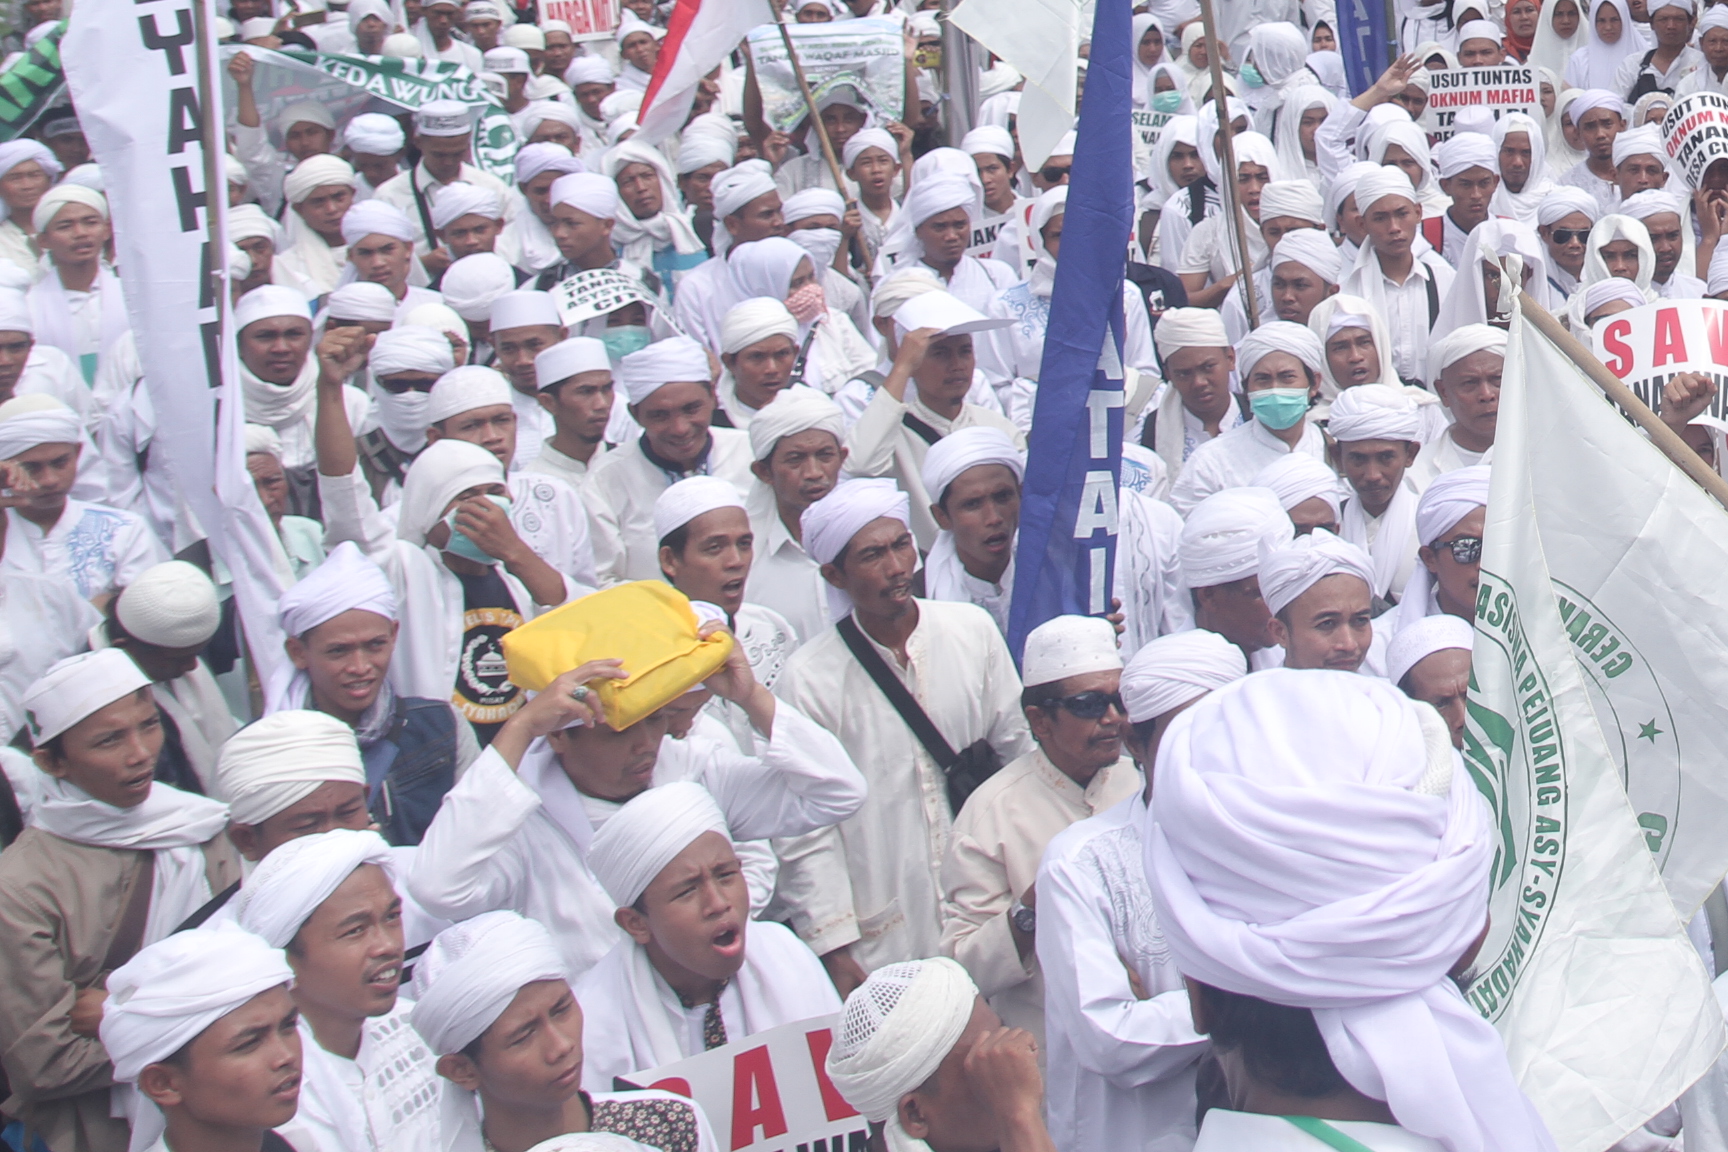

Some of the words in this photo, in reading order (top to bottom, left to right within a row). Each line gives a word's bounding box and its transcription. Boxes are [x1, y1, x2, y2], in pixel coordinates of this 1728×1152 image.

[315, 54, 479, 104] KEDAWUNG
[1430, 90, 1482, 108] OKNUM
[1487, 88, 1536, 105] MAFIA
[1431, 72, 1469, 89] USUT
[1472, 68, 1533, 86] TUNTAS
[1662, 98, 1692, 139] USUT
[1666, 110, 1714, 159] OKNUM
[1517, 674, 1562, 807] PEJUANG
